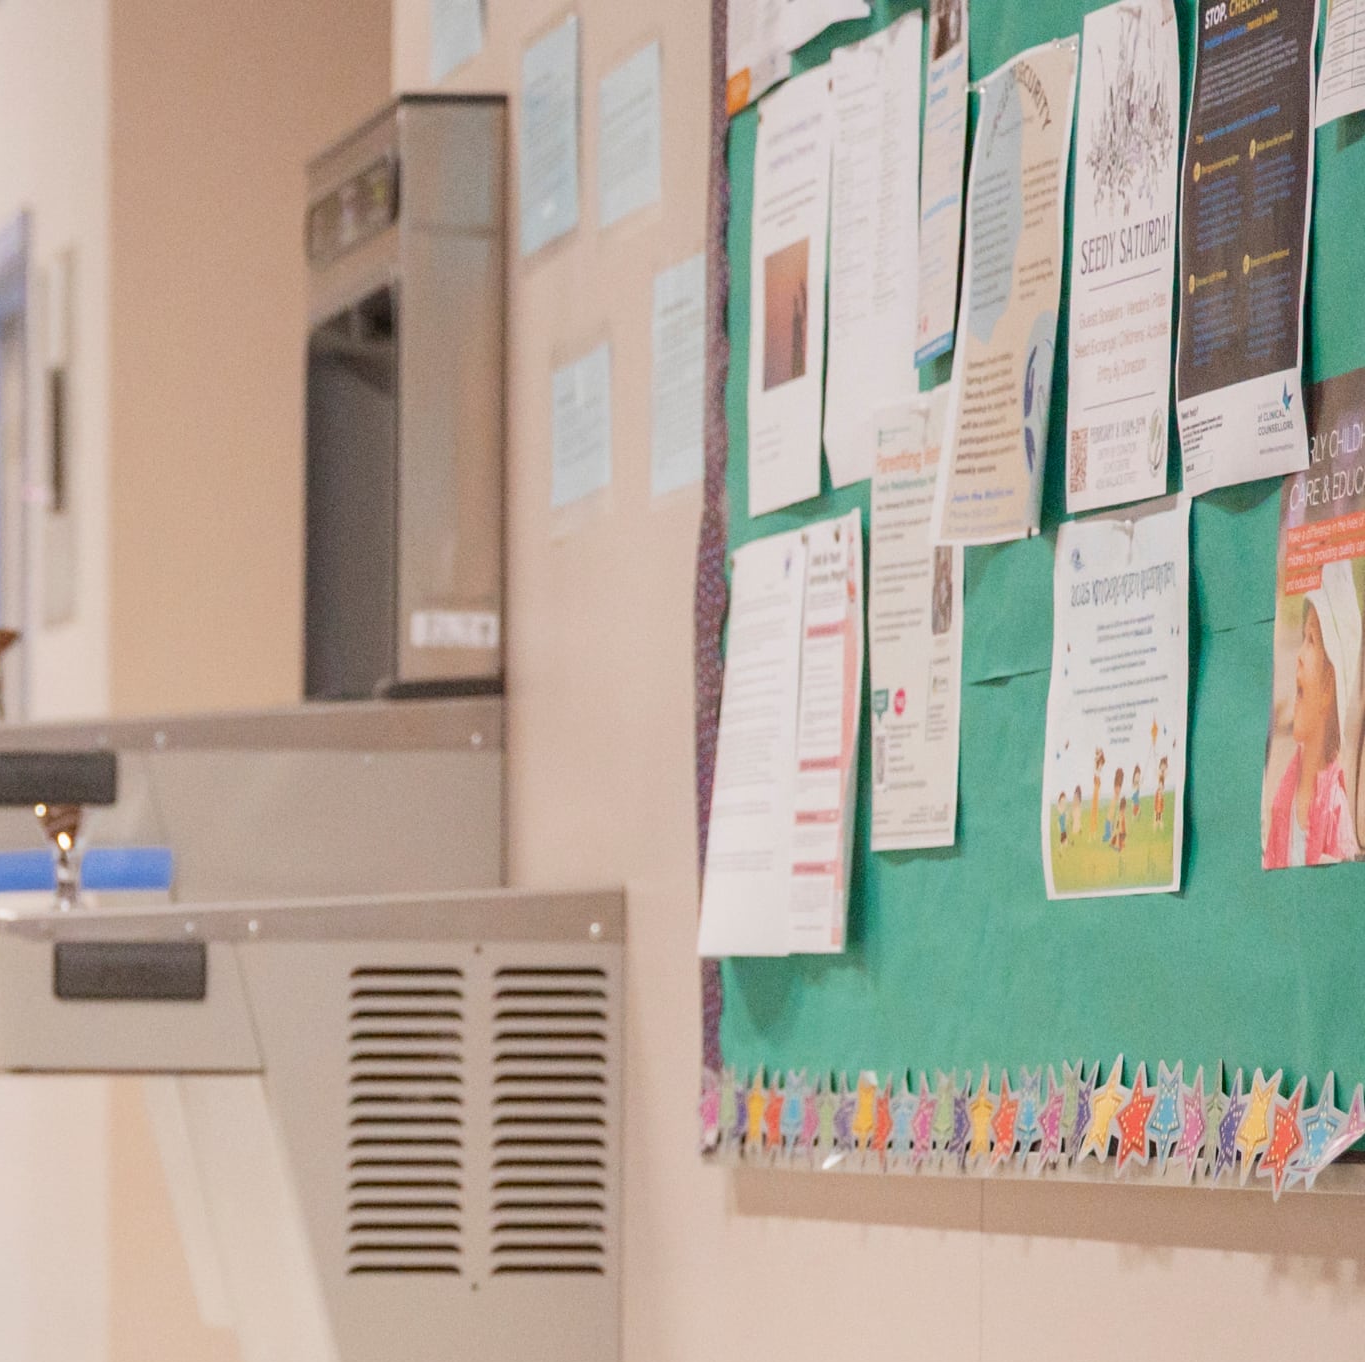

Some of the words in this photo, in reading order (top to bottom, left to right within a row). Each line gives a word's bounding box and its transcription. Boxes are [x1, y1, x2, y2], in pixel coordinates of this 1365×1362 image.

[1205, 2, 1227, 30] STOP.
[1080, 231, 1116, 275] SEEDY
[1119, 211, 1173, 264] SATURDAY
[1258, 420, 1293, 436] COUNSELLORS
[1263, 409, 1285, 422] CLINICAL
[1289, 477, 1320, 511] CARE
[1322, 475, 1330, 504] &
